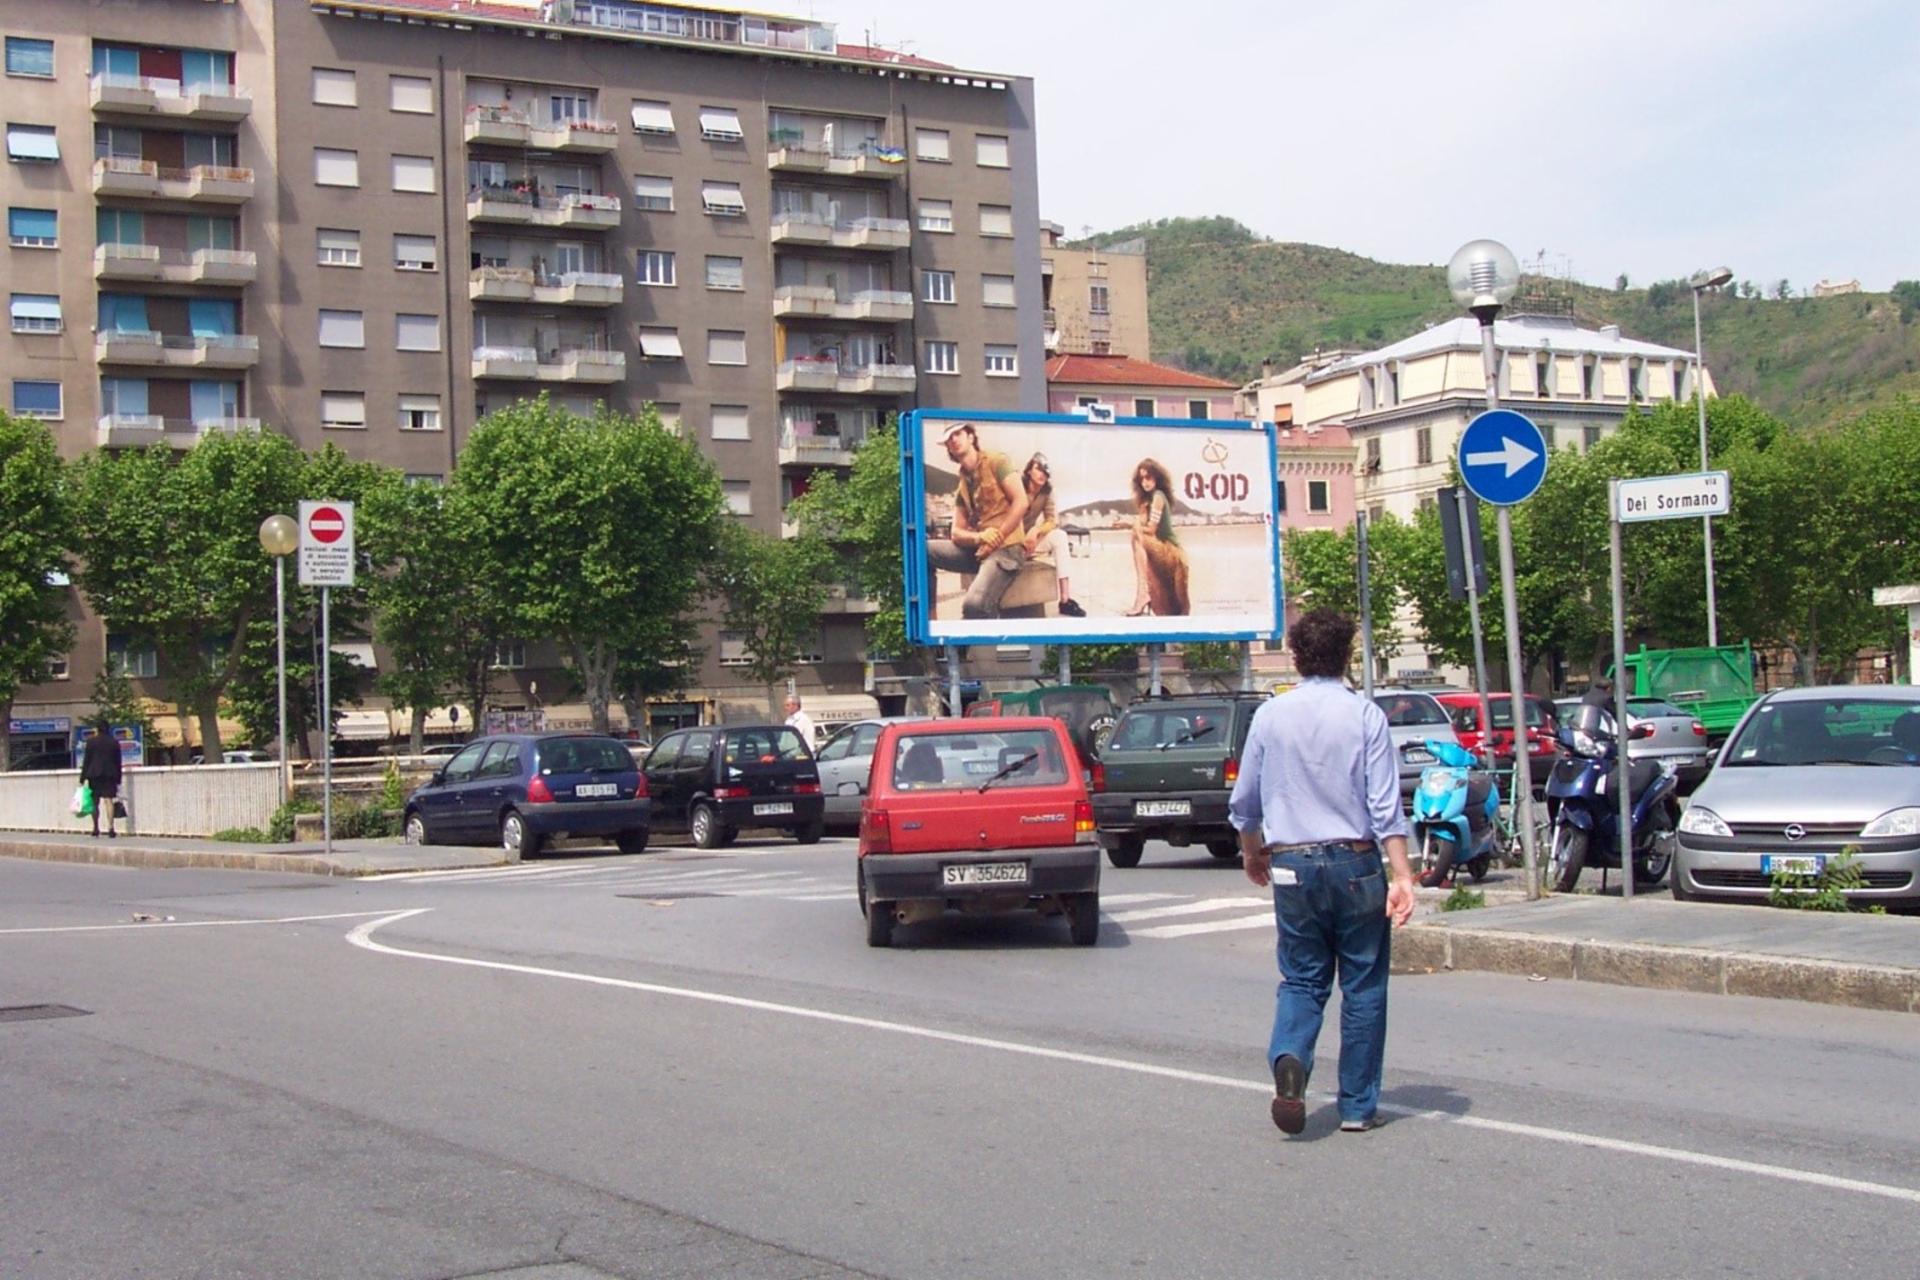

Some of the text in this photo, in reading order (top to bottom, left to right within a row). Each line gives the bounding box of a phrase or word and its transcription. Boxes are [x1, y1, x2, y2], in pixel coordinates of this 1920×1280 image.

[1627, 494, 1718, 512] Dei Sormano
[947, 864, 1025, 882] SV 354622
